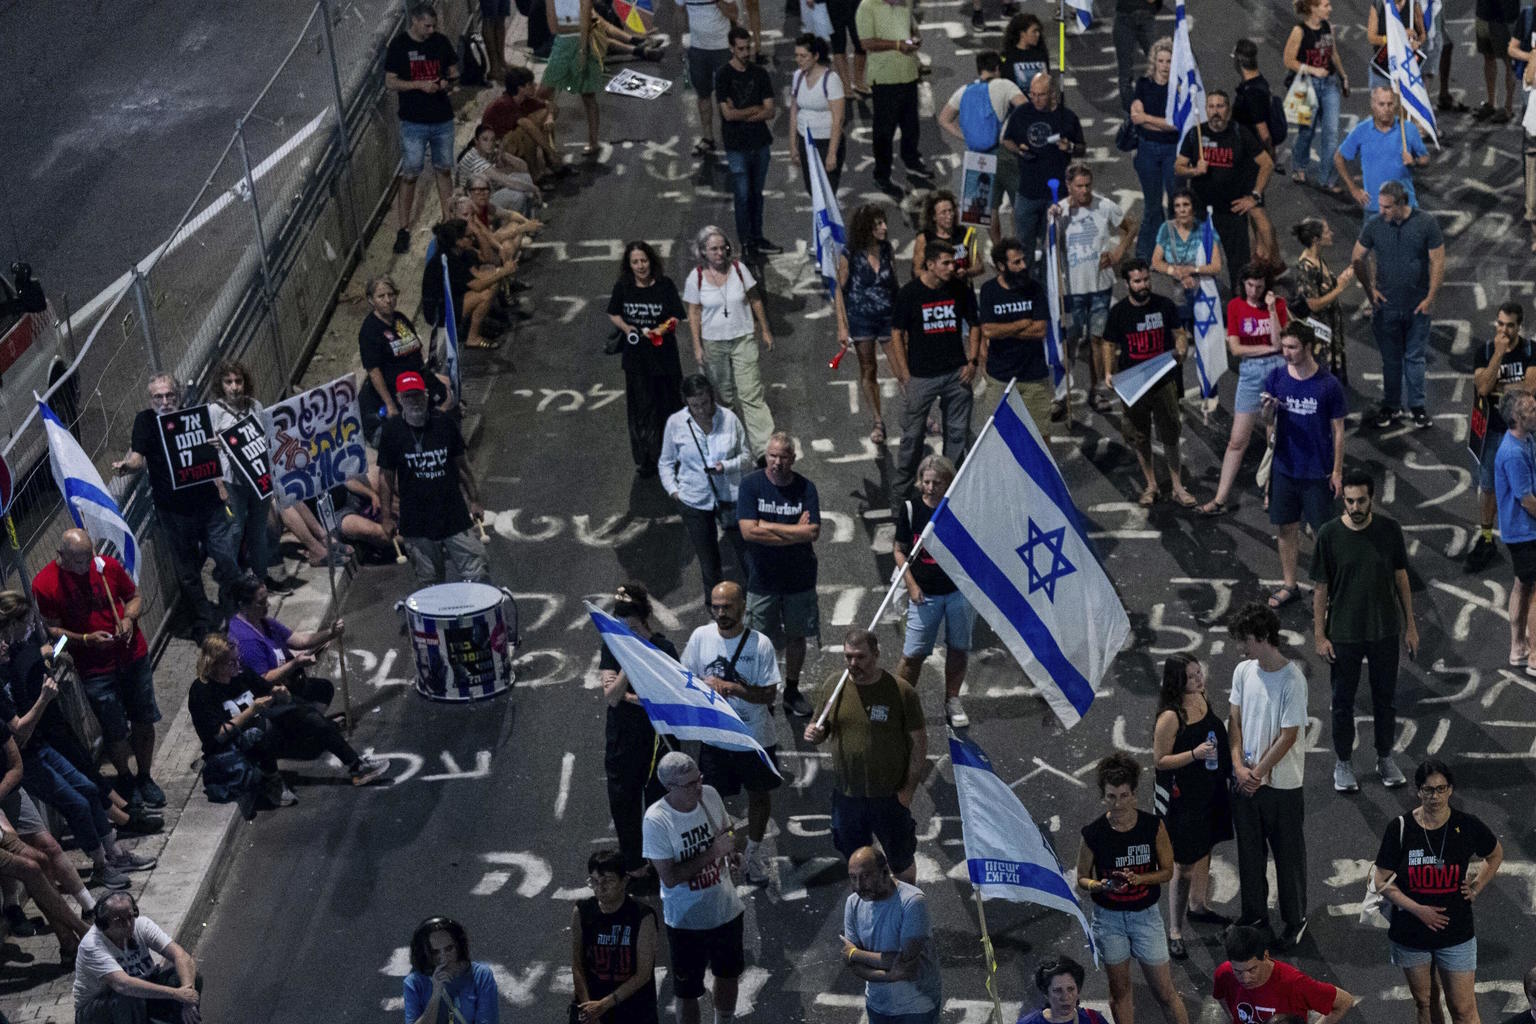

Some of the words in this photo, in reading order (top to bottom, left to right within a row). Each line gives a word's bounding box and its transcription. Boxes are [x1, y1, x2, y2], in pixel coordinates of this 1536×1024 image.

[624, 303, 663, 317] שבעה
[922, 305, 956, 322] FCK
[180, 413, 202, 432] אל
[175, 429, 206, 450] תתנו
[238, 422, 260, 443] אל
[179, 450, 193, 467] לו
[405, 447, 448, 468] שבעה
[251, 458, 267, 476] לו
[758, 498, 803, 516] Timberland
[682, 823, 711, 847] אתה
[1408, 849, 1425, 857] BRING
[1408, 857, 1422, 866] THEM
[1422, 856, 1438, 865] HOME
[688, 869, 721, 891] אשם
[1408, 864, 1460, 889] NOW!
